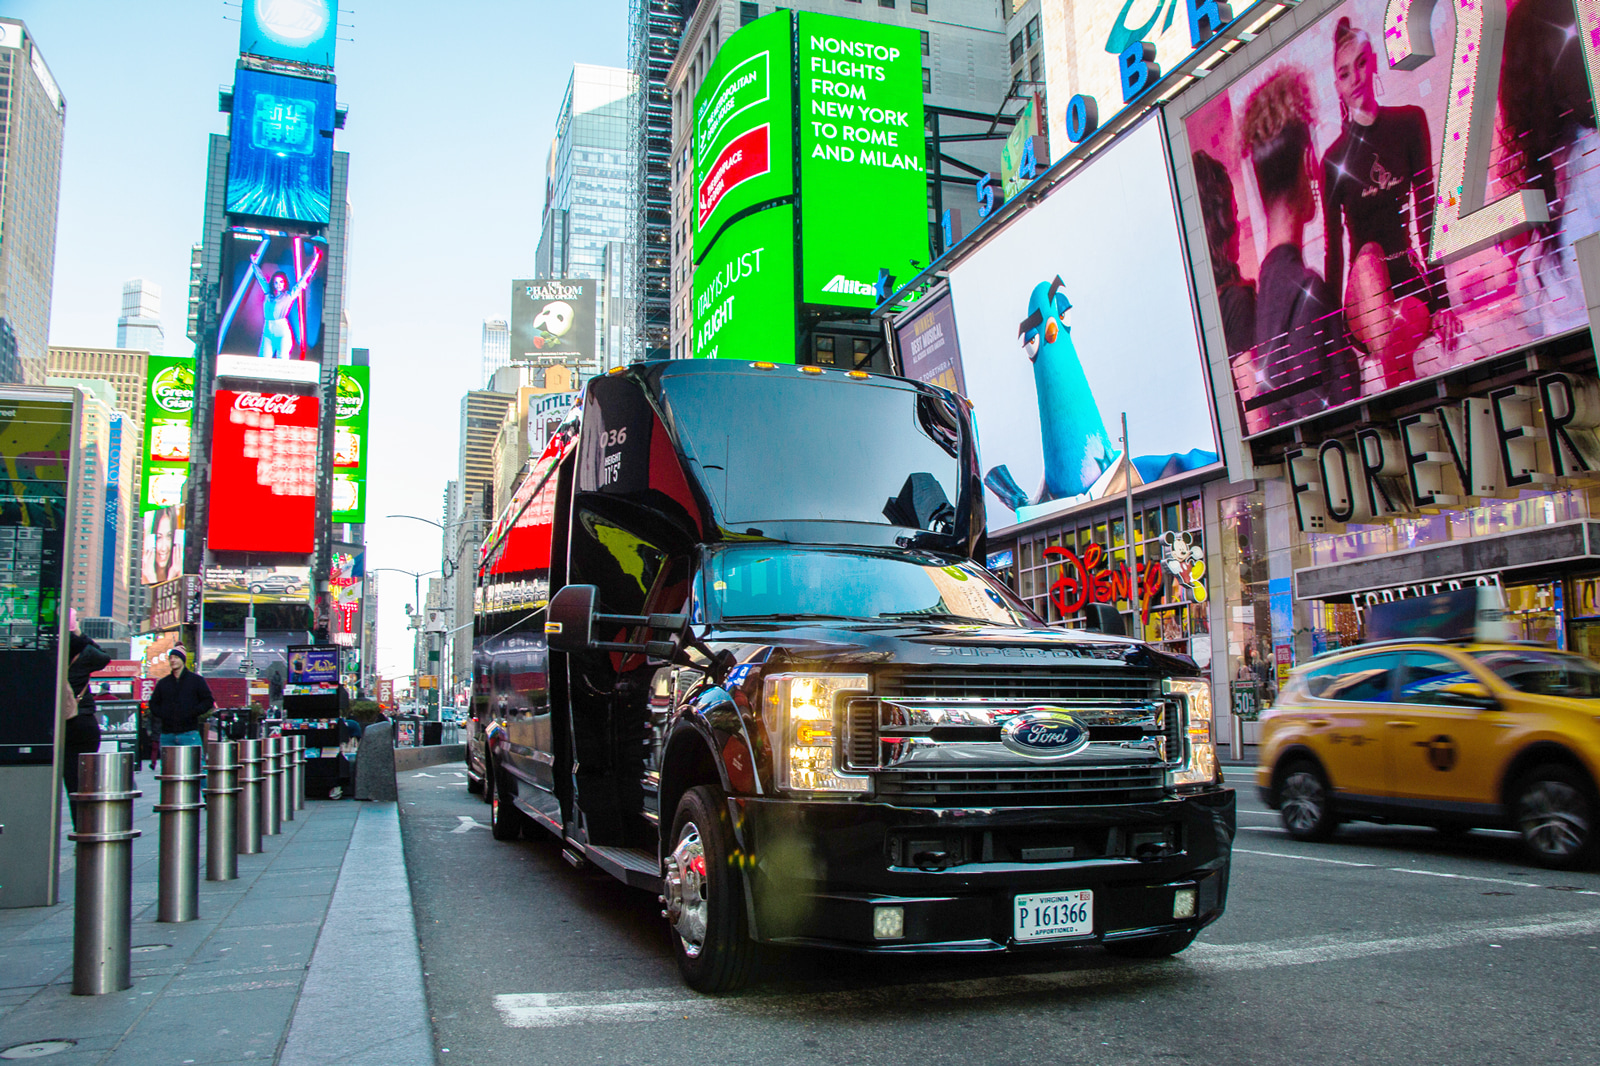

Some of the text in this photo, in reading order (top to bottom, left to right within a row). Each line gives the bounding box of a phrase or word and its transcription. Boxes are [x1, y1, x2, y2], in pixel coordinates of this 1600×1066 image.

[810, 35, 900, 62] NONSTOP
[811, 56, 886, 82] FLIGHTS
[715, 70, 757, 117] METROPOLITAN
[811, 78, 867, 101] FROM
[717, 96, 735, 123] HOUSE
[811, 99, 909, 127] NEW YORK
[811, 121, 899, 148] TO ROME
[714, 149, 743, 187] BIRTHPLACE
[811, 143, 924, 172] AND MILAN.
[525, 286, 583, 296] PHANTOM
[698, 247, 765, 320] ITALY IS JUST
[697, 329, 704, 354] A
[703, 294, 735, 346] FLIGHT
[911, 322, 944, 356] BEST MUSICAL
[922, 361, 948, 382] TOGETHER
[162, 397, 194, 408] Gian
[536, 394, 572, 416] LITTLE
[600, 426, 627, 450] 036
[106, 427, 122, 492] NOVOTEL
[604, 452, 622, 468] HEIGHT
[1284, 371, 1598, 534] FOREVER
[157, 595, 177, 613] SIDE
[153, 608, 179, 627] STORY
[929, 646, 1047, 659] SUPER
[141, 679, 155, 702] tkts
[379, 681, 392, 702] tkts
[1027, 723, 1069, 744] Ford
[1039, 895, 1070, 904] VIRGINIA
[1019, 902, 1088, 929] P 161366
[1034, 926, 1075, 936] APPORTIONED
